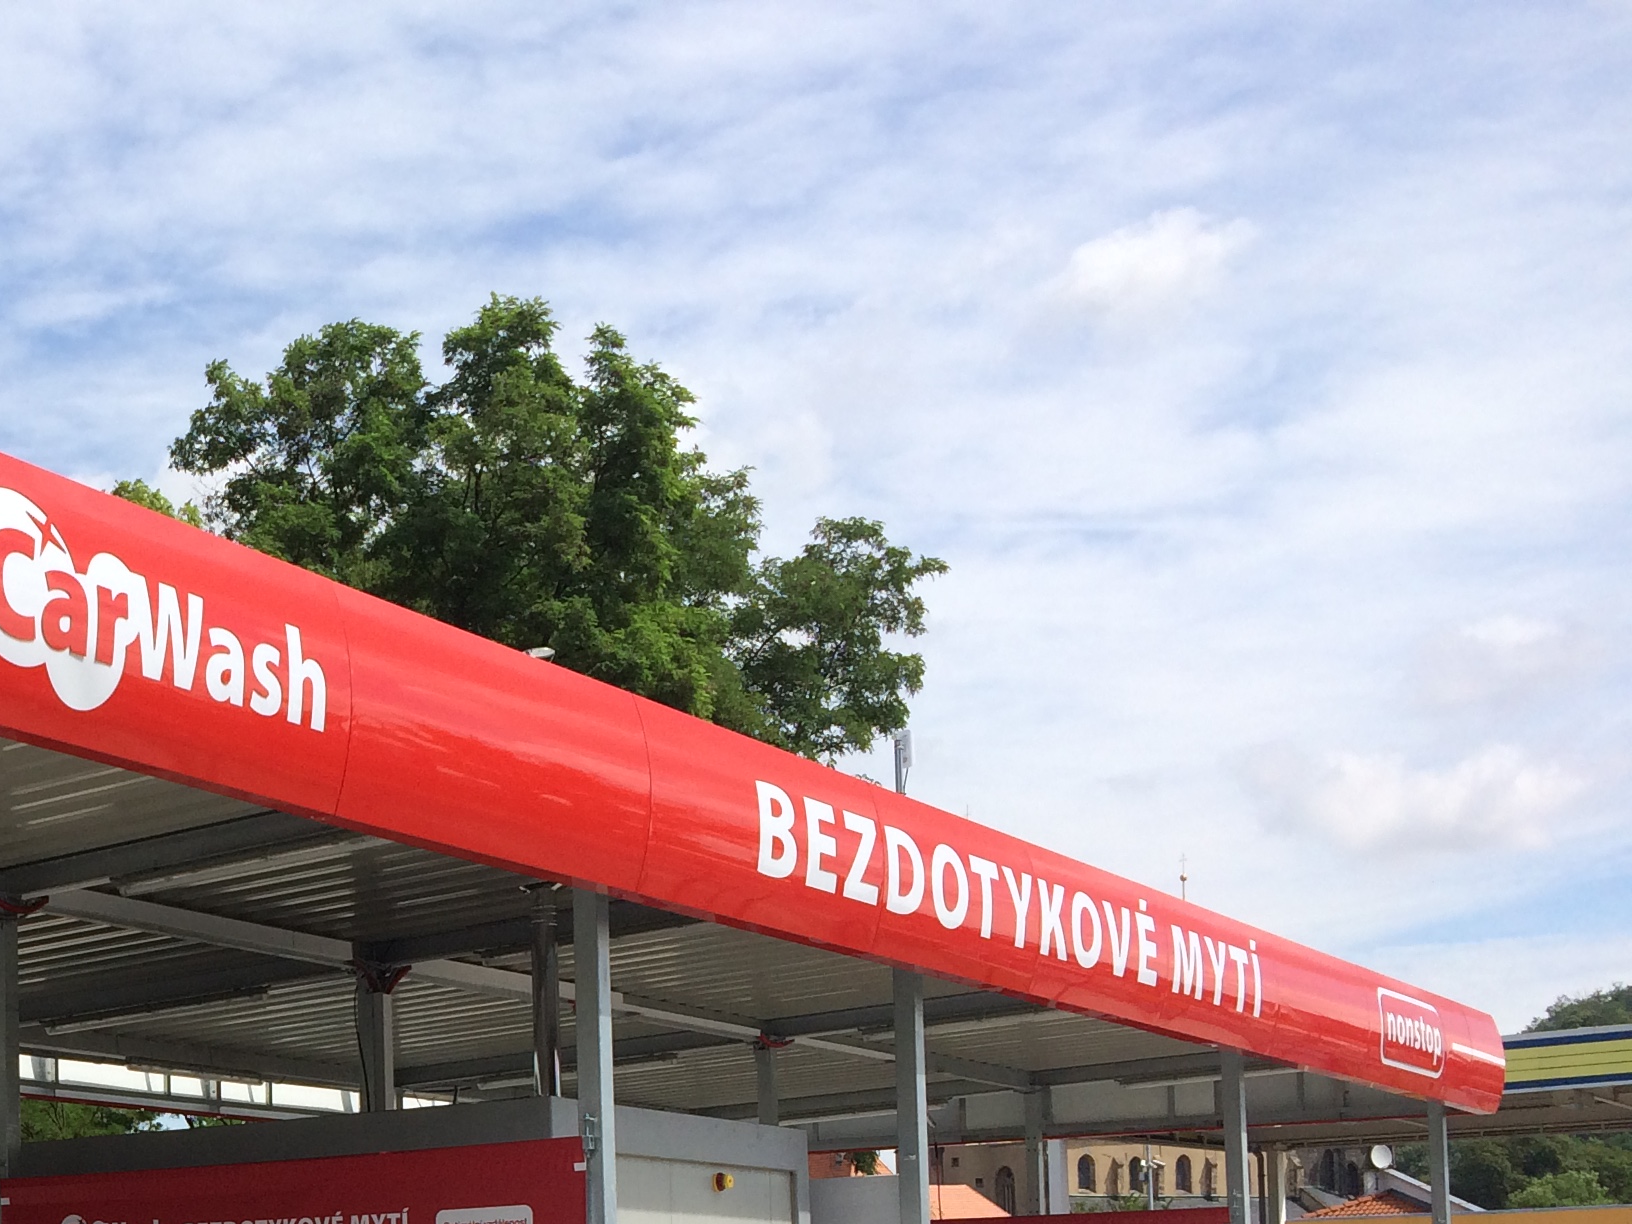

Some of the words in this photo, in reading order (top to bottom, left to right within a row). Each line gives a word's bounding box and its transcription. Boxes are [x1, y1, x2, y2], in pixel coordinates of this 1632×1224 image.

[754, 779, 1159, 988] BEZDOTYKOVÉ
[1171, 925, 1264, 1019] MYTÍ
[1387, 1009, 1442, 1057] nonstop
